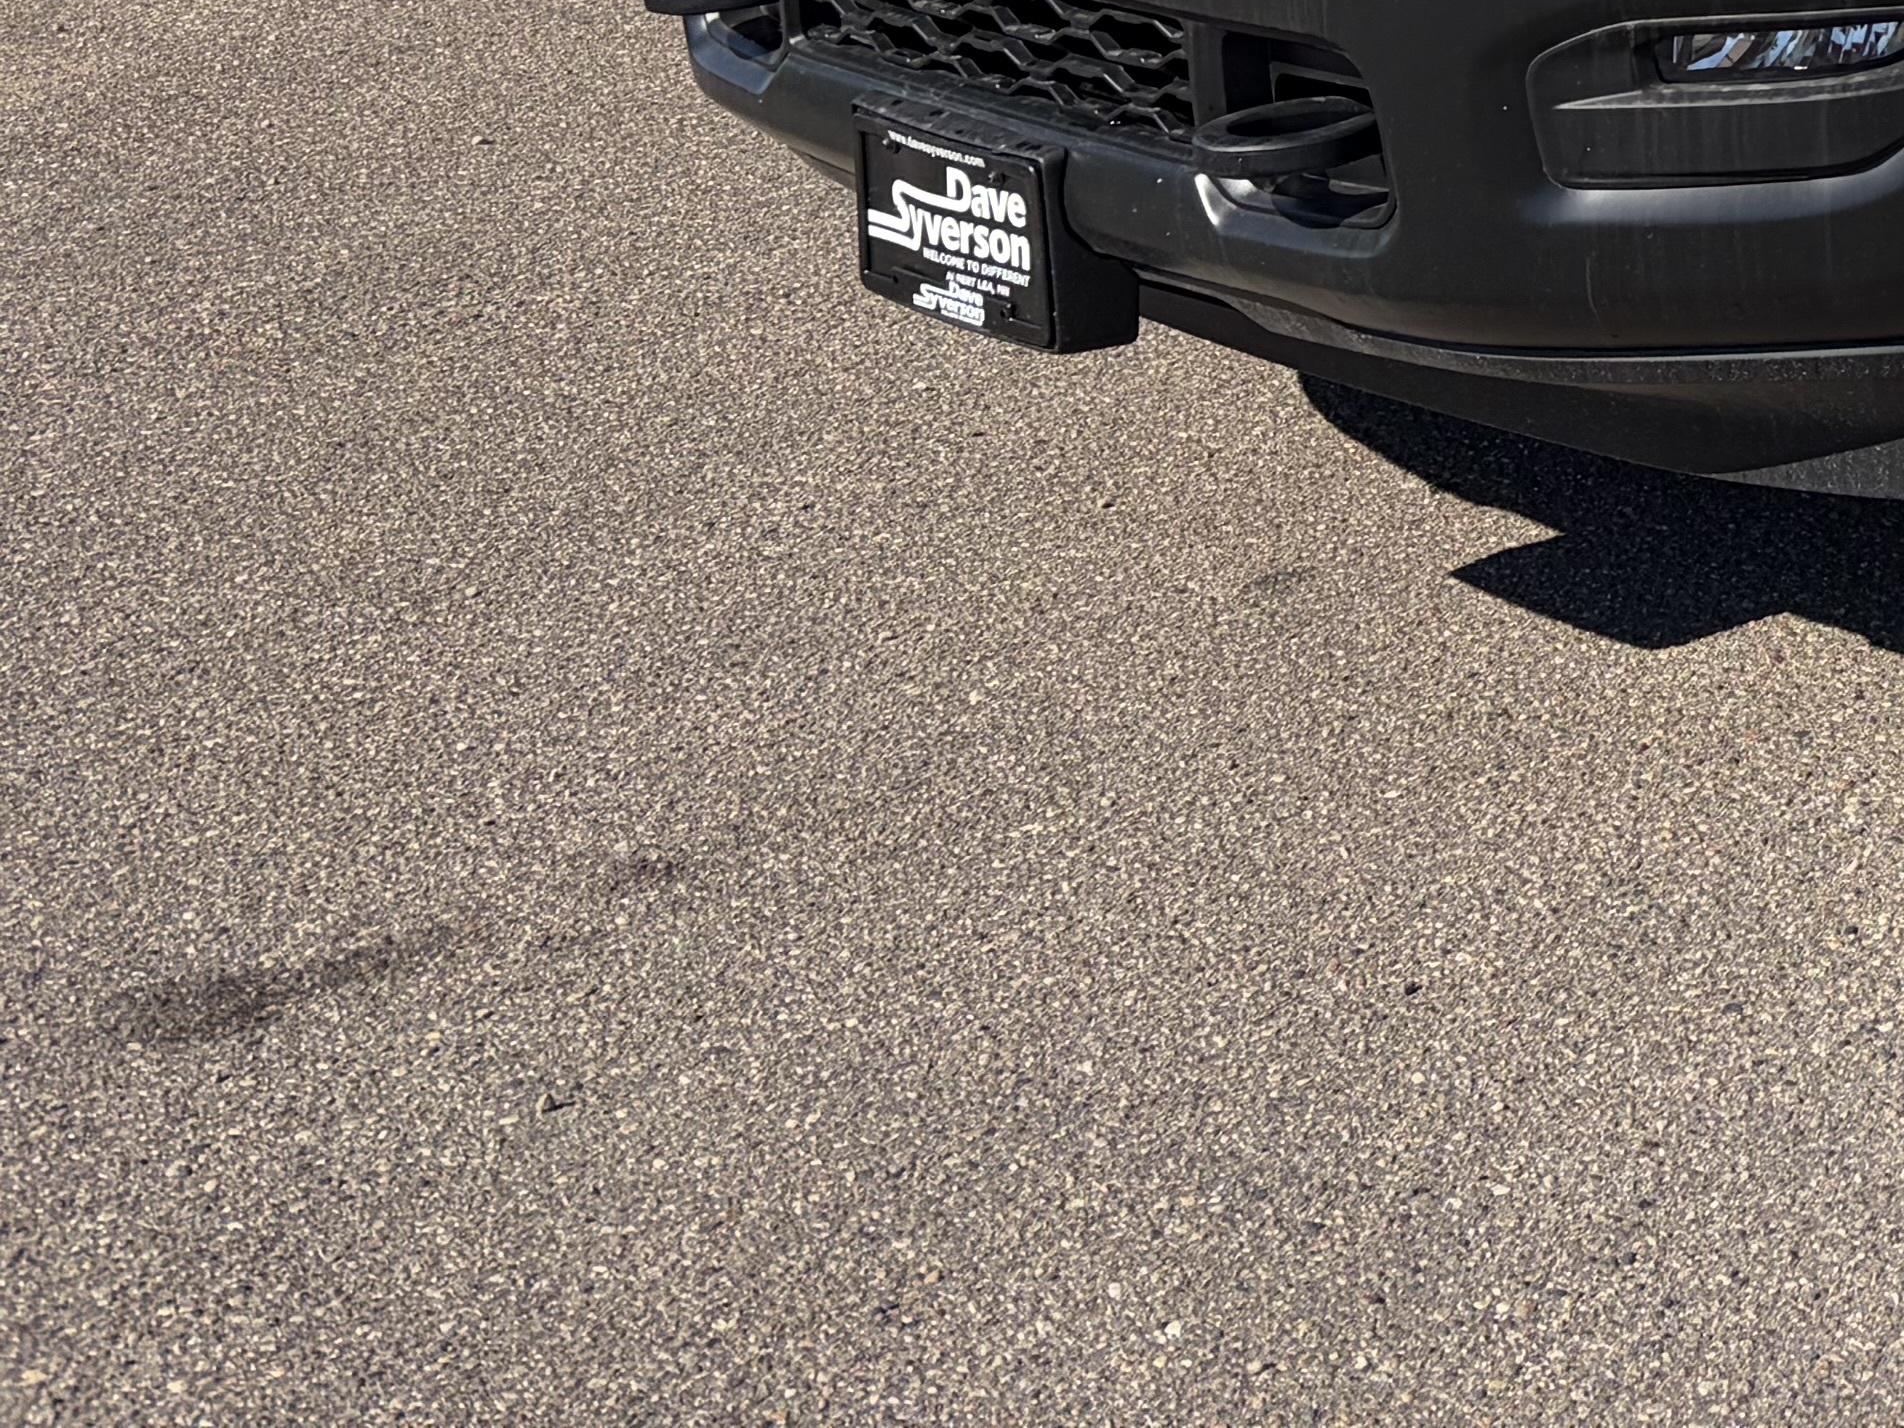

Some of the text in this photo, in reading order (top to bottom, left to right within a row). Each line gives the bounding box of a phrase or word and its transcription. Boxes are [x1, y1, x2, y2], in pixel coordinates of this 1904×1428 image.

[868, 179, 1031, 272] Syverson
[945, 166, 1027, 228] Dave
[923, 246, 1031, 288] WELCOME TO DIFFERENT
